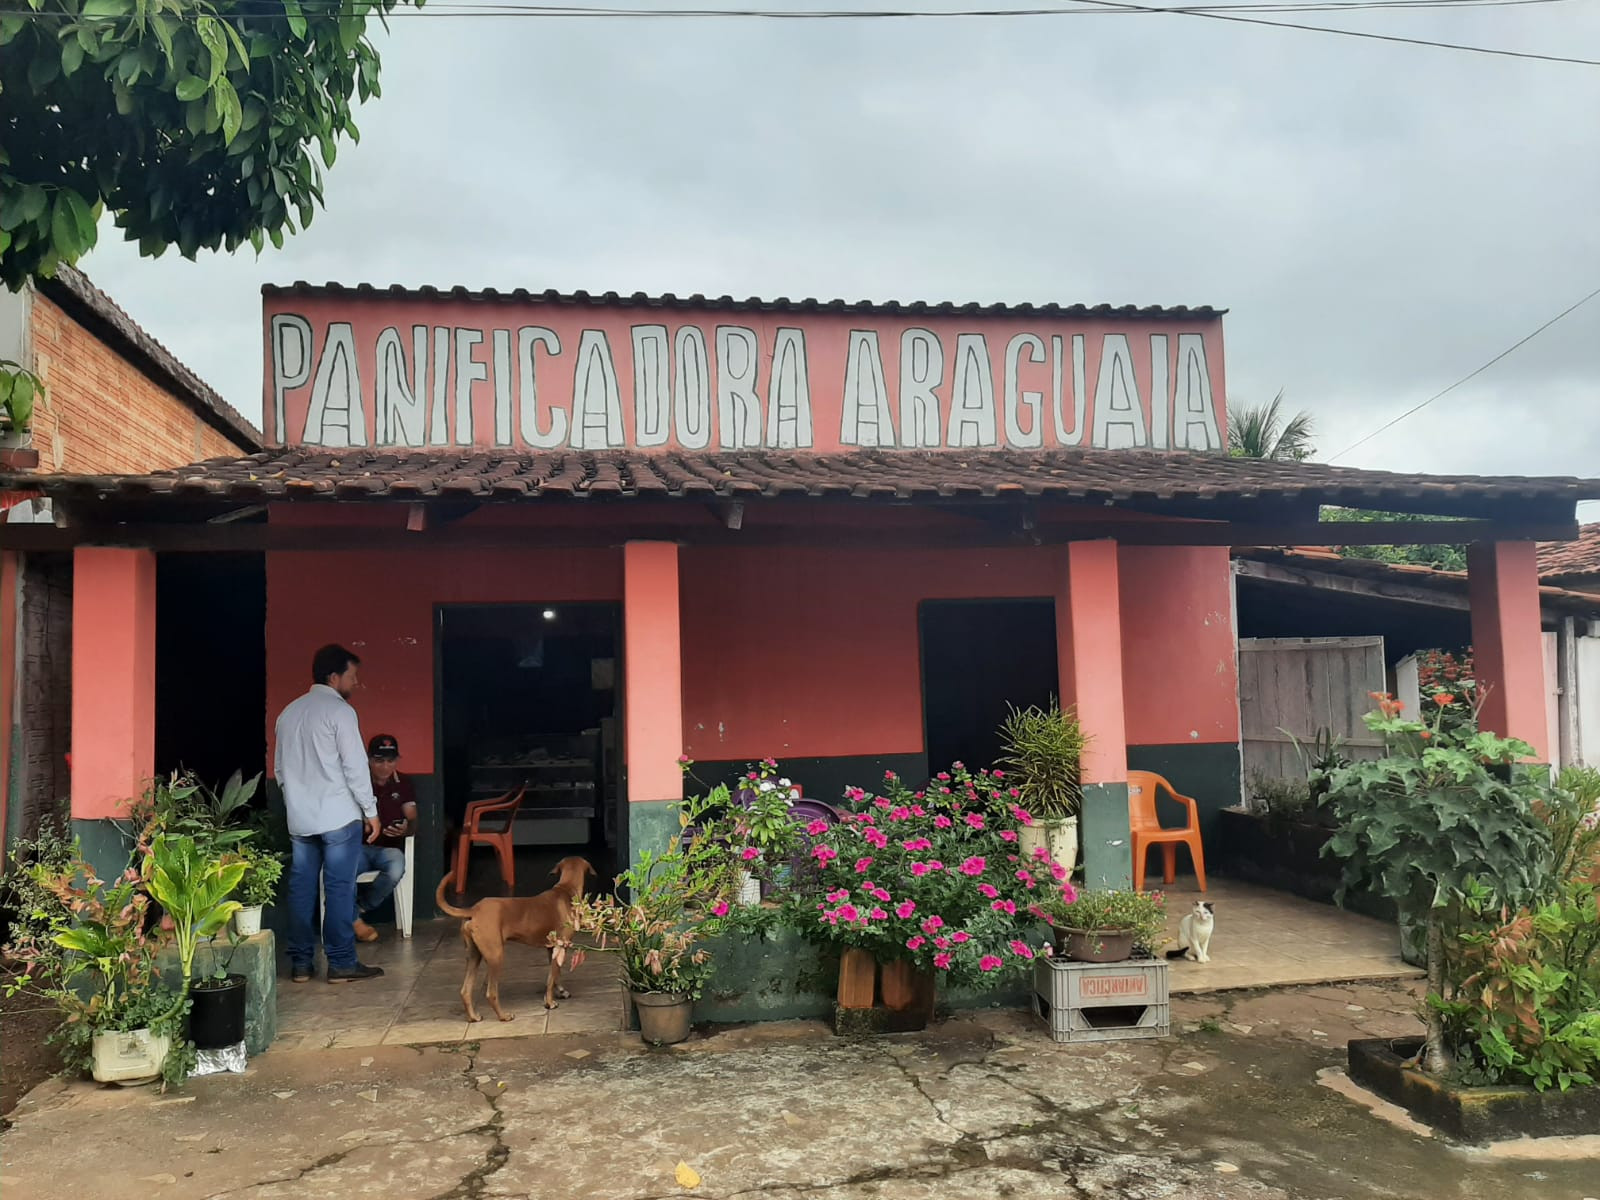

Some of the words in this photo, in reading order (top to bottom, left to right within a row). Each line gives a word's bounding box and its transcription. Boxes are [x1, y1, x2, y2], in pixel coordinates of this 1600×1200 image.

[271, 313, 814, 450] PANIFICADORA
[838, 326, 1223, 451] ARAGUAIA
[1081, 977, 1144, 995] ANTARCTICA
